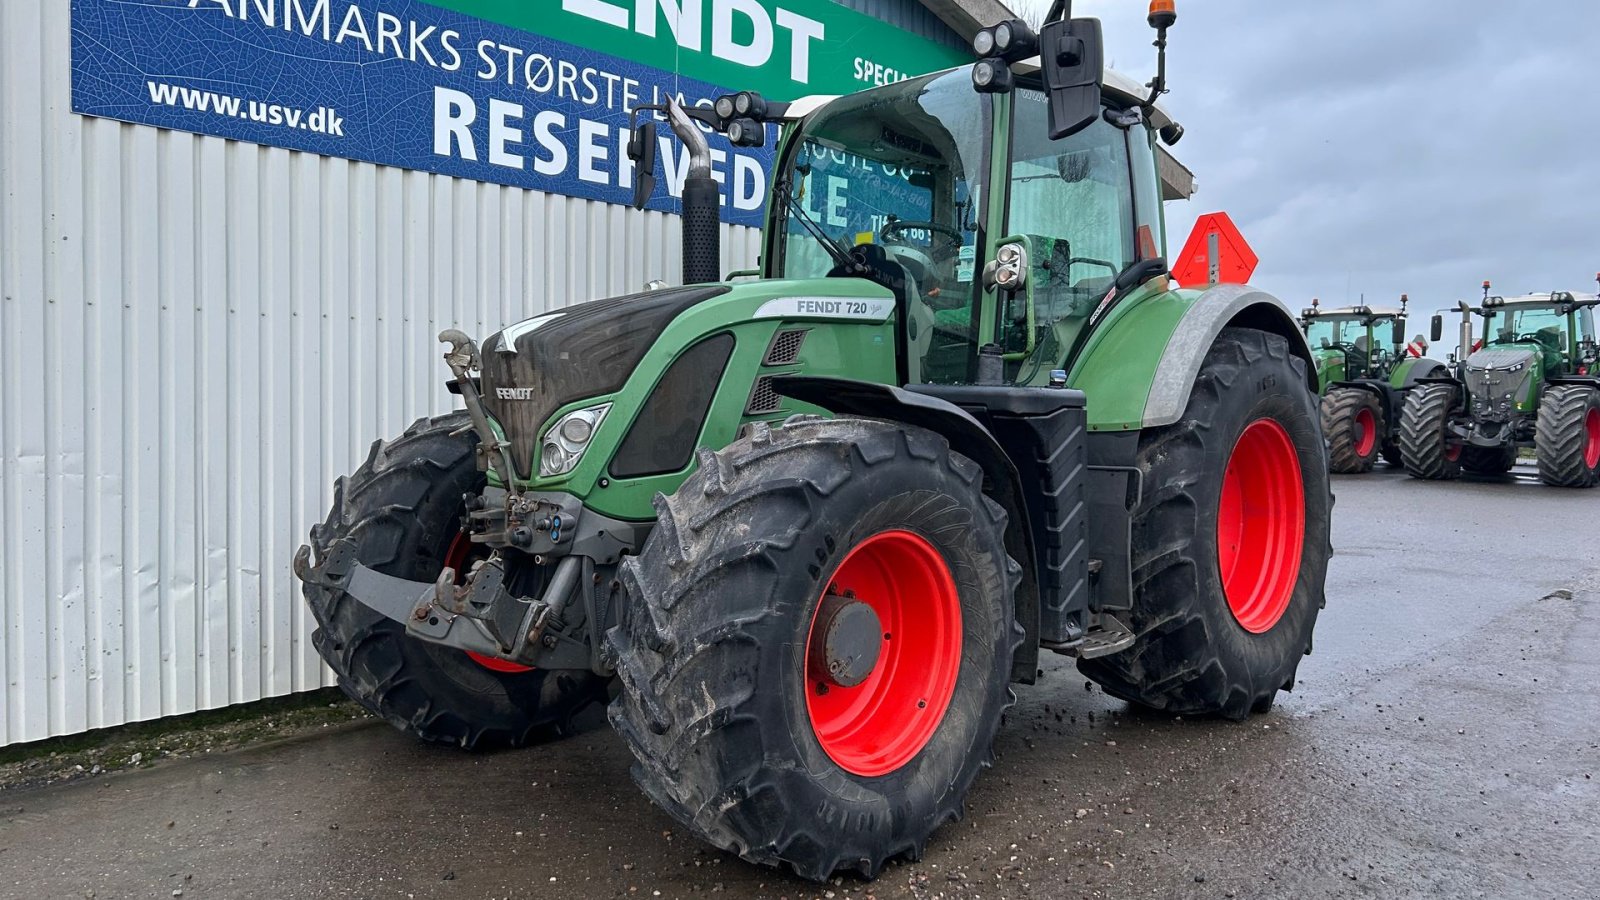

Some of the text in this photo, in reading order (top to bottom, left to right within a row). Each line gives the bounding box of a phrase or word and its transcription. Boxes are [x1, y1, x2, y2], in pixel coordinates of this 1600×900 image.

[562, 0, 825, 84] NDT
[478, 39, 639, 115] STØRSTE
[147, 80, 344, 137] www.usv.dk
[797, 300, 842, 314] FENDT
[845, 302, 868, 314] 720
[495, 387, 534, 400] FENDT
